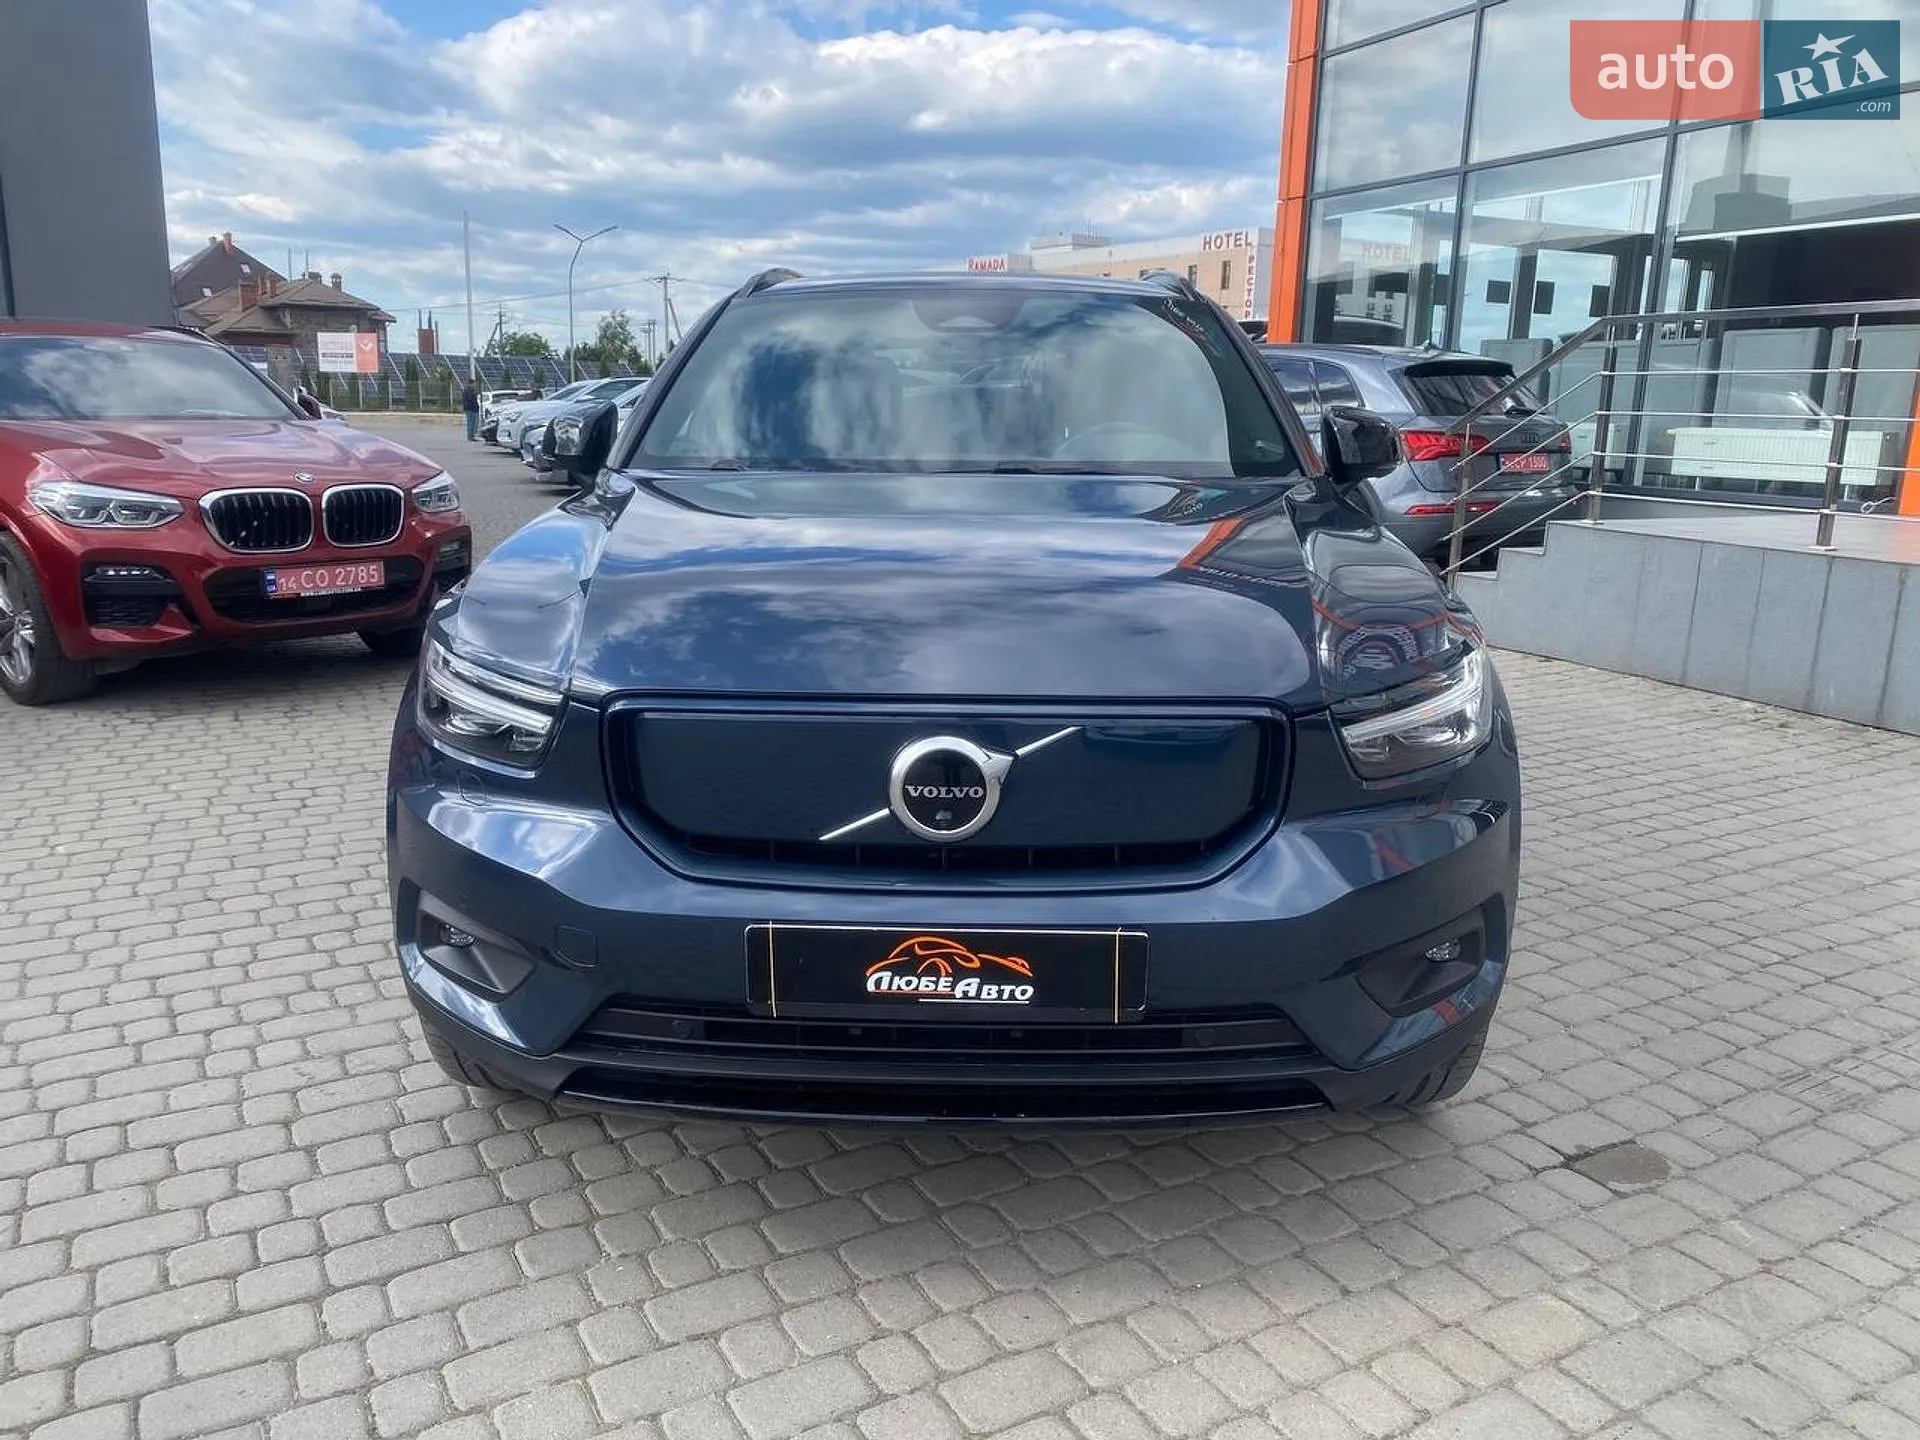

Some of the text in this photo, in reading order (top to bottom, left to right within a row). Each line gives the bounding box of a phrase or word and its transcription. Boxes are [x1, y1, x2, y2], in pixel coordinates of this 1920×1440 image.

[1203, 231, 1252, 251] HOTEL
[967, 256, 1006, 271] RAMADA
[279, 565, 378, 591] 14 CO 2785
[904, 785, 984, 798] VOLVO
